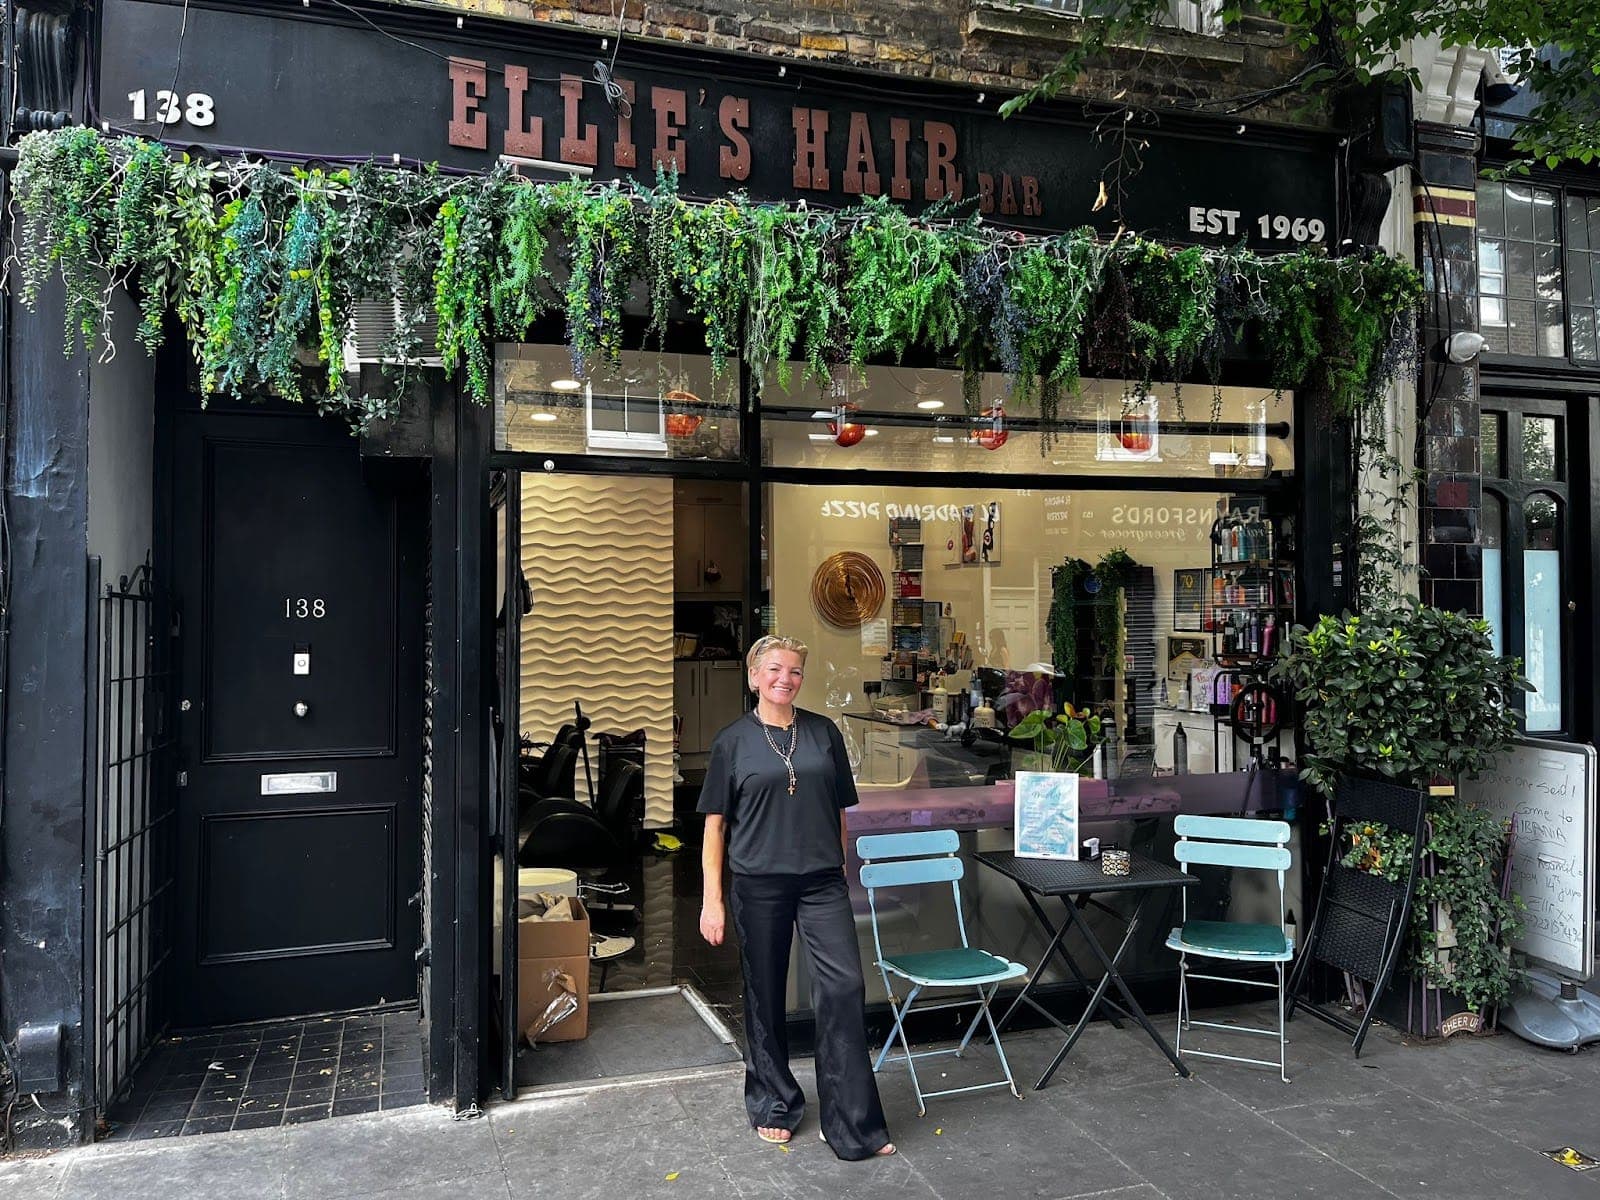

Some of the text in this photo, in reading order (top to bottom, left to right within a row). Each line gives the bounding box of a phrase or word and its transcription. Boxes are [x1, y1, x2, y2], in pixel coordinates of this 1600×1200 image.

[127, 88, 216, 127] 138
[448, 55, 1043, 217] ELLIE'S HAIR BAR
[1189, 206, 1326, 243] EST 1969
[285, 598, 326, 618] 138
[1441, 1016, 1469, 1034] CHEER
